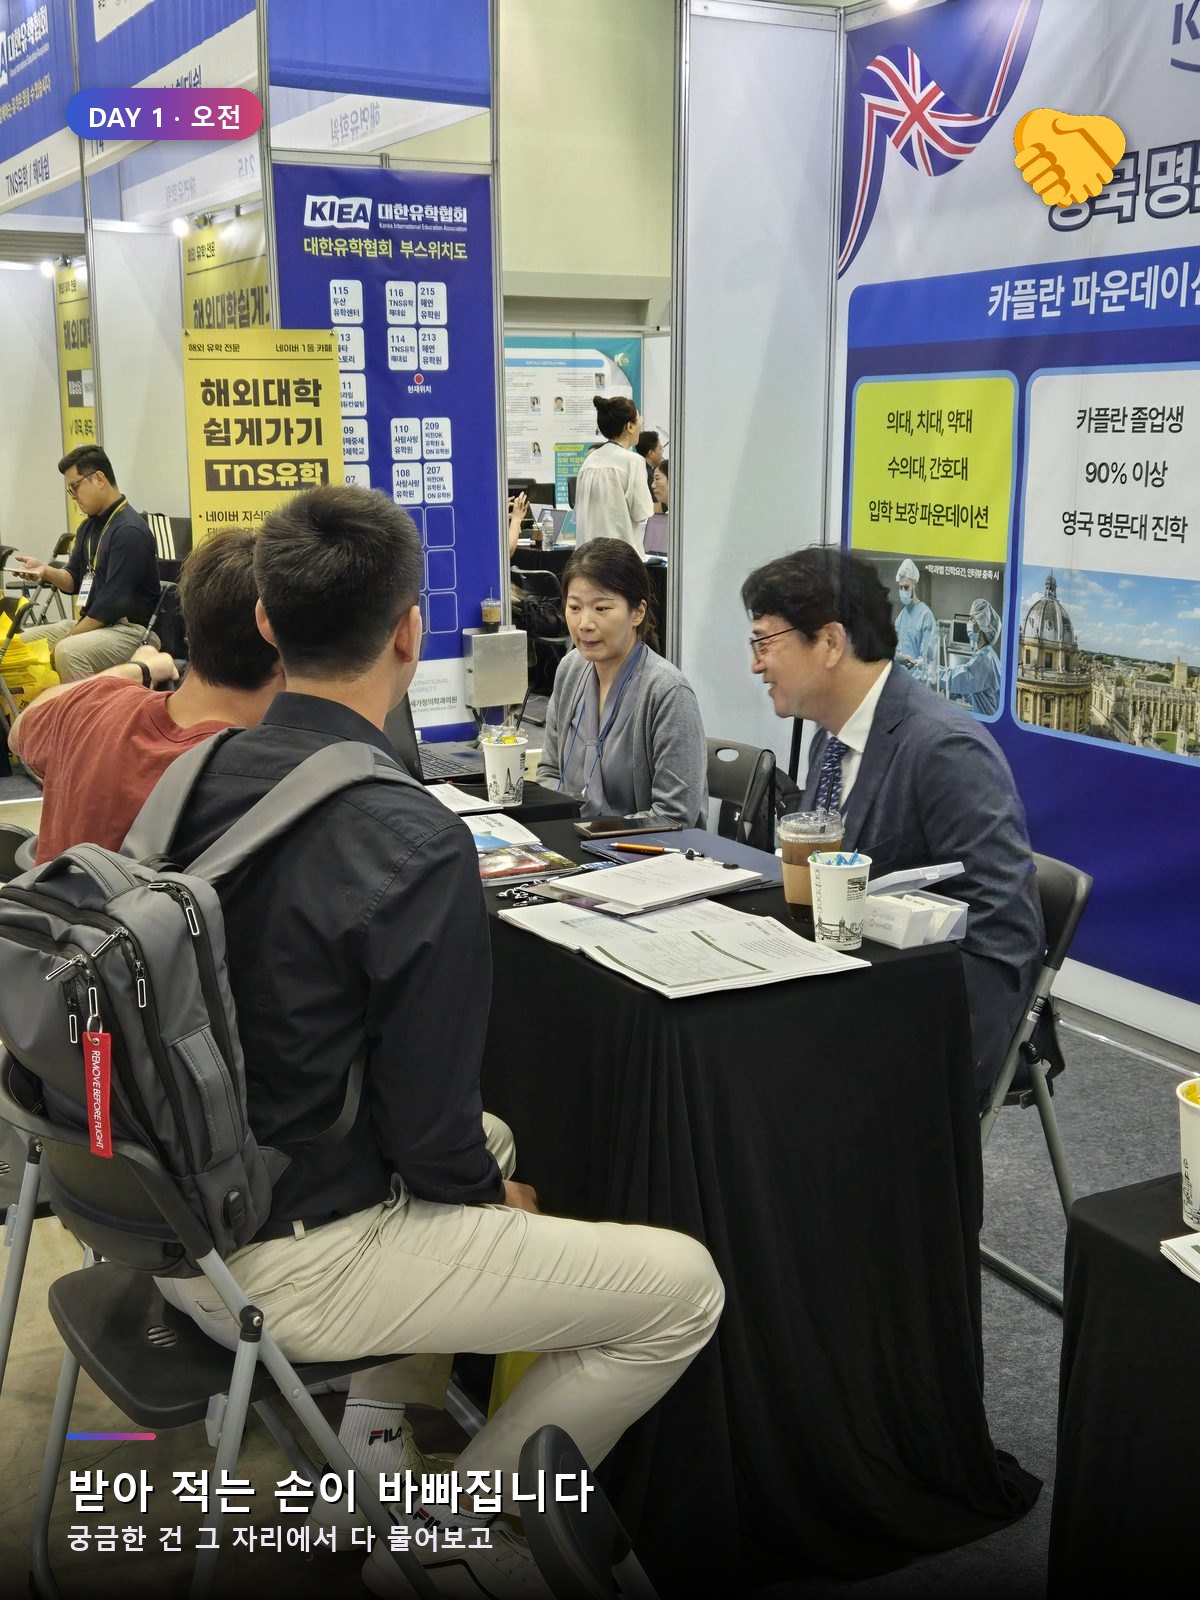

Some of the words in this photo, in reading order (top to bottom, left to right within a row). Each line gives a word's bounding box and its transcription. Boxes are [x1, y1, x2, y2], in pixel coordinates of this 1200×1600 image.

[309, 200, 370, 224] KIEA
[377, 203, 468, 224] 대한유학협회
[303, 236, 393, 258] 대한유학협회
[400, 240, 468, 260] 부스위치도
[333, 286, 349, 295] 115
[389, 289, 404, 297] 116
[420, 287, 435, 296] 215
[333, 297, 346, 306] 두산
[988, 275, 1065, 321] 카플란
[389, 299, 414, 307] TNS유학
[333, 308, 360, 317] 유학센터
[420, 311, 441, 320] 유학원
[338, 333, 351, 341] 13
[391, 335, 405, 343] 114
[421, 333, 437, 342] 213
[188, 343, 204, 353] 해외
[206, 343, 222, 353] 유학
[224, 343, 240, 353] 전문
[275, 343, 299, 353] 네이버
[316, 343, 332, 353] 카페
[422, 356, 442, 365] 유학원
[200, 378, 322, 407] 해외대학
[407, 385, 432, 394] 현재위치
[886, 410, 914, 437] 의대,
[916, 409, 945, 437] 치대,
[947, 409, 973, 434] 약대
[1076, 406, 1128, 434] 카플란
[1130, 405, 1184, 434] 졸업생
[394, 425, 409, 433] 110
[425, 422, 440, 430] 209
[203, 417, 323, 447] 쉽게가기
[394, 435, 419, 443] 사람사랑
[395, 446, 413, 455] 유학원
[396, 469, 410, 477] 108
[426, 466, 441, 474] 207
[887, 456, 927, 483] 수의대,
[929, 457, 968, 481] 간호대
[1085, 461, 1128, 485] 90%
[1132, 460, 1168, 488] 이상
[395, 480, 420, 488] 사람사랑
[396, 490, 414, 498] 유학원
[206, 510, 239, 523] 네이버
[869, 499, 893, 523] 입학
[895, 501, 919, 525] 보장
[919, 503, 989, 529] 파운데이션
[1062, 510, 1094, 537] 영국
[1097, 512, 1148, 541] 명문대
[1151, 515, 1189, 543] 진학
[993, 571, 1000, 581] 시
[91, 1050, 101, 1088] REMOVE
[93, 1088, 101, 1122] BEFORE
[94, 1122, 104, 1149] FLIGHT
